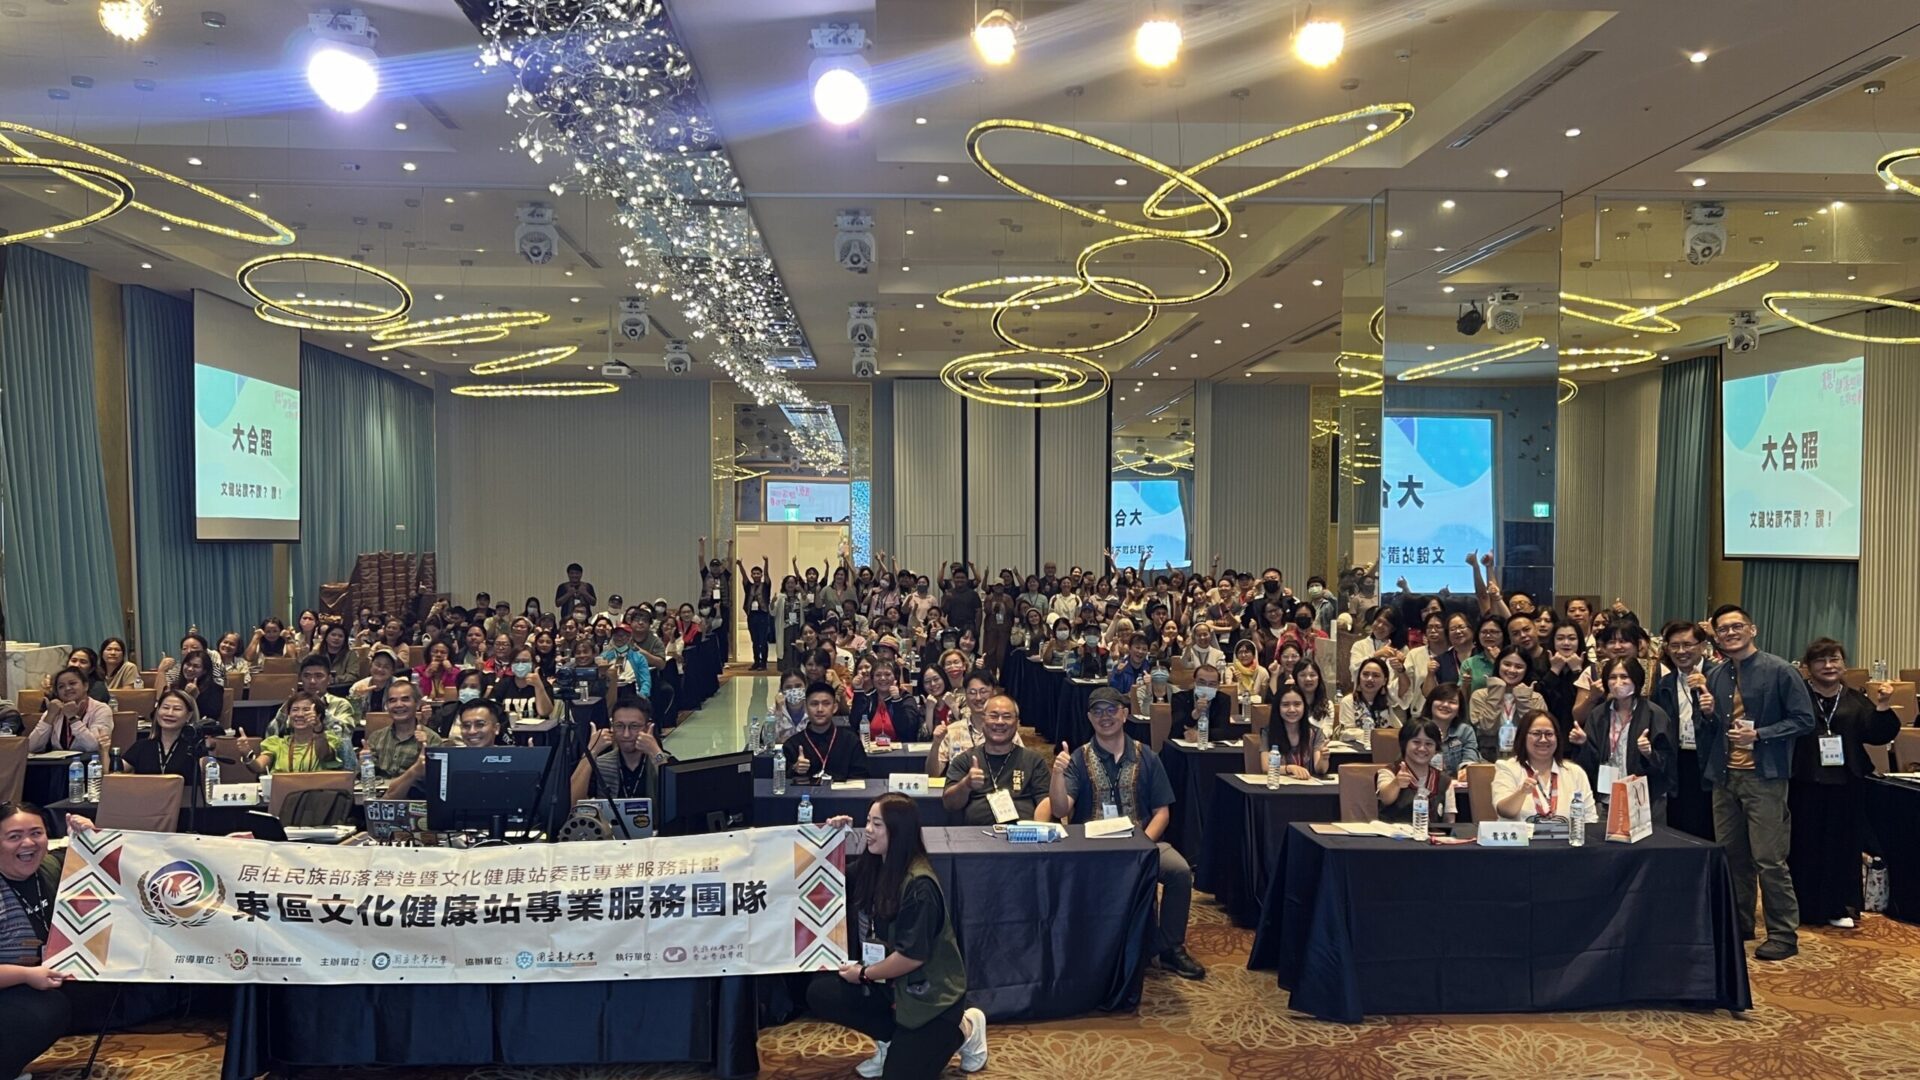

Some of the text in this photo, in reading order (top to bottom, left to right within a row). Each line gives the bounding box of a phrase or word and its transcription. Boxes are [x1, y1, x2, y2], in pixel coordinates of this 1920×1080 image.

[232, 422, 273, 457] 大合照
[1761, 431, 1819, 471] 大合照
[482, 755, 512, 763] ASUS
[237, 857, 721, 888] 原住民族部落營造暨文化健康站委託專業服務計畫
[232, 880, 768, 929] 東區文化健康站專業服務團隊
